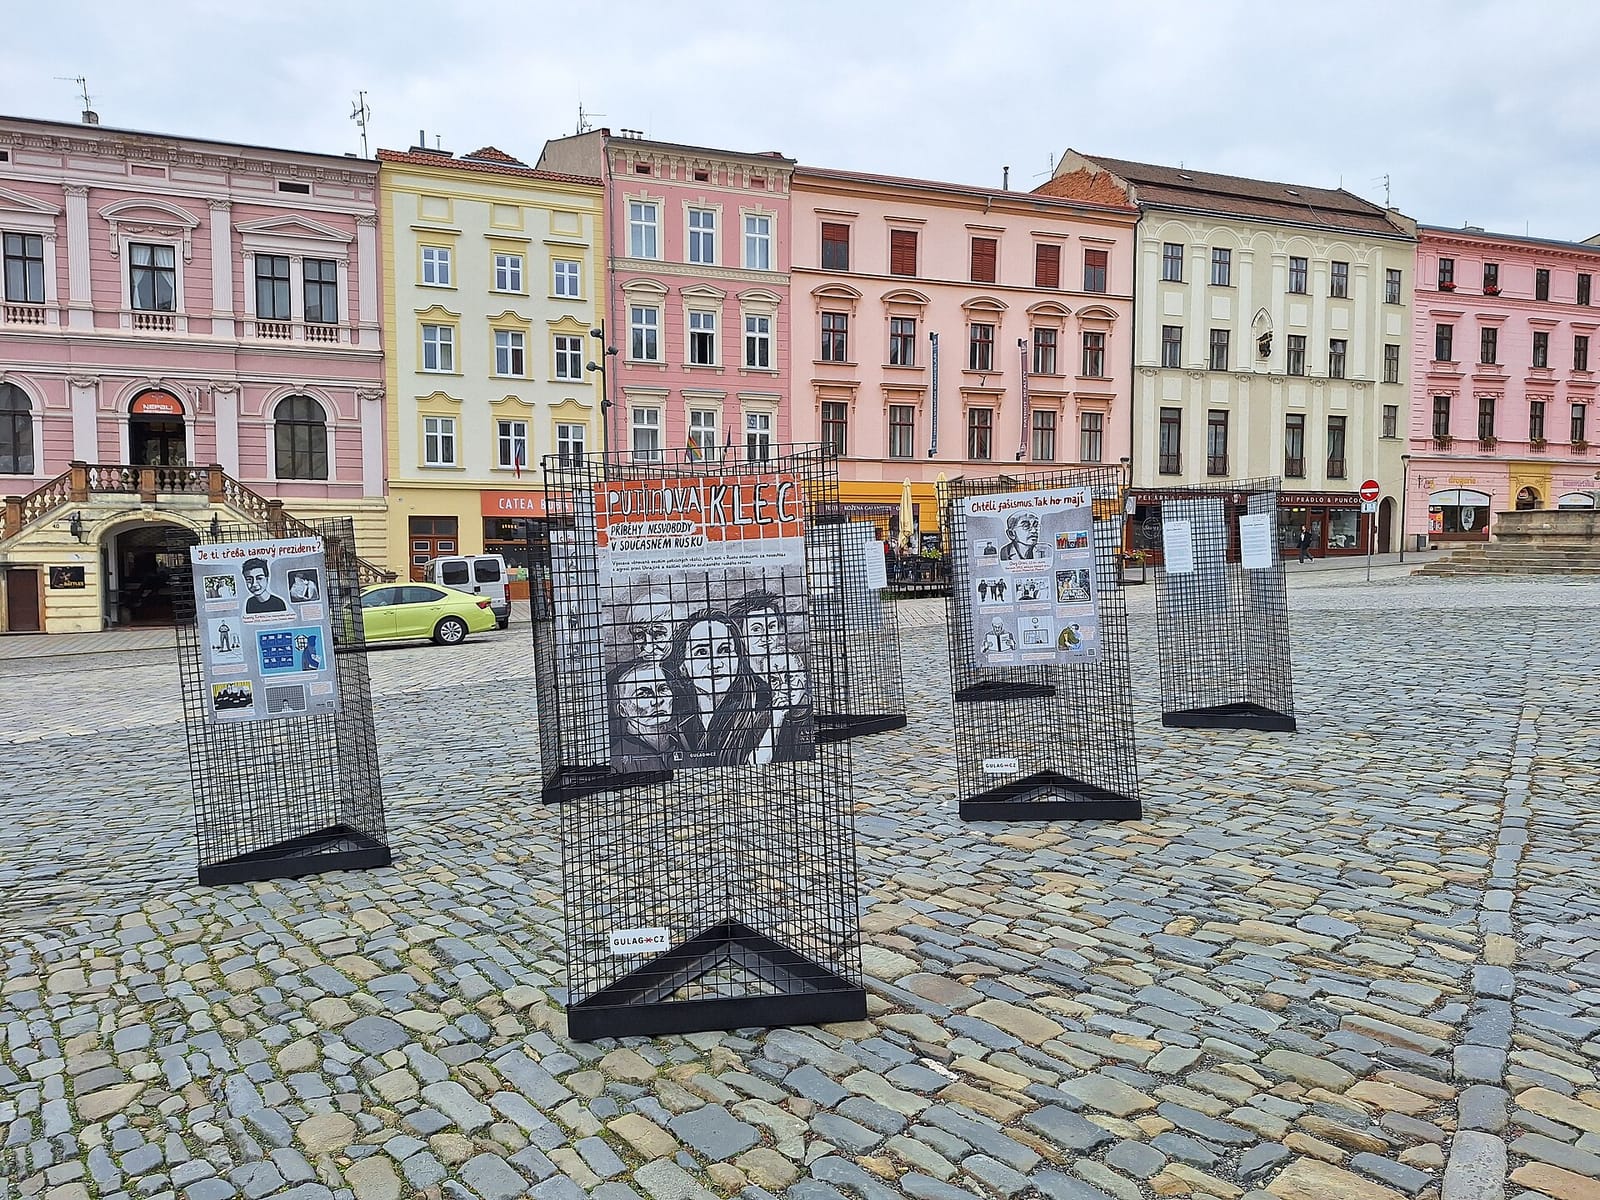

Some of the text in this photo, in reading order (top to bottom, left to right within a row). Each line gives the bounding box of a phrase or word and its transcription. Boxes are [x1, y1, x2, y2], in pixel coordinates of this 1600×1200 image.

[499, 498, 534, 510] CATEA
[709, 481, 796, 527] KLEC
[971, 501, 997, 513] Chtěli
[1034, 496, 1048, 508] Tak
[1049, 496, 1062, 506] ho
[1063, 491, 1085, 508] mají
[647, 522, 693, 534] NESVOBODY
[611, 542, 616, 551] V
[674, 536, 703, 549] RUSKU
[198, 550, 208, 561] Je
[211, 548, 220, 559] ti
